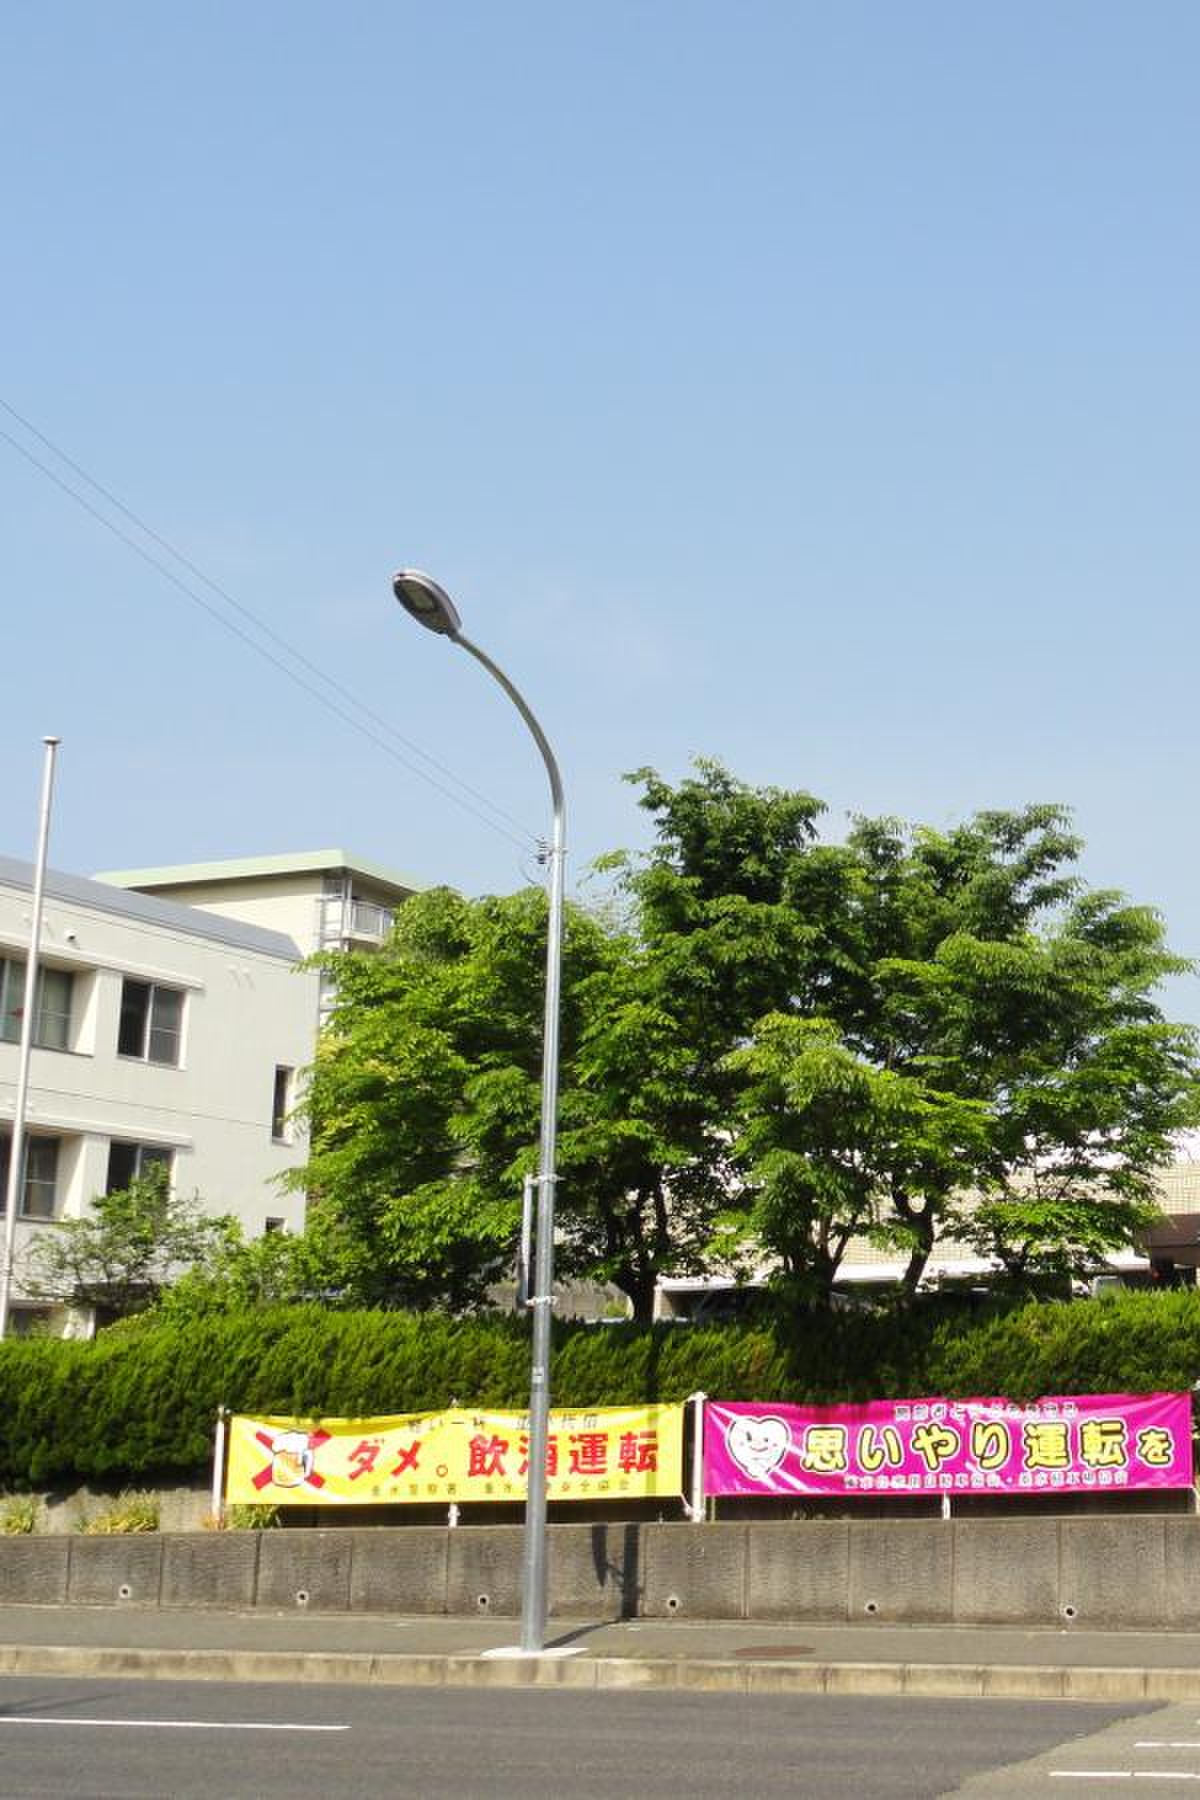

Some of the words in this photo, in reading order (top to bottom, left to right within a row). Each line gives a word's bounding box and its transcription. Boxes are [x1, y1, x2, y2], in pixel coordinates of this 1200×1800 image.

[802, 1418, 1174, 1473] 思いやり運転を
